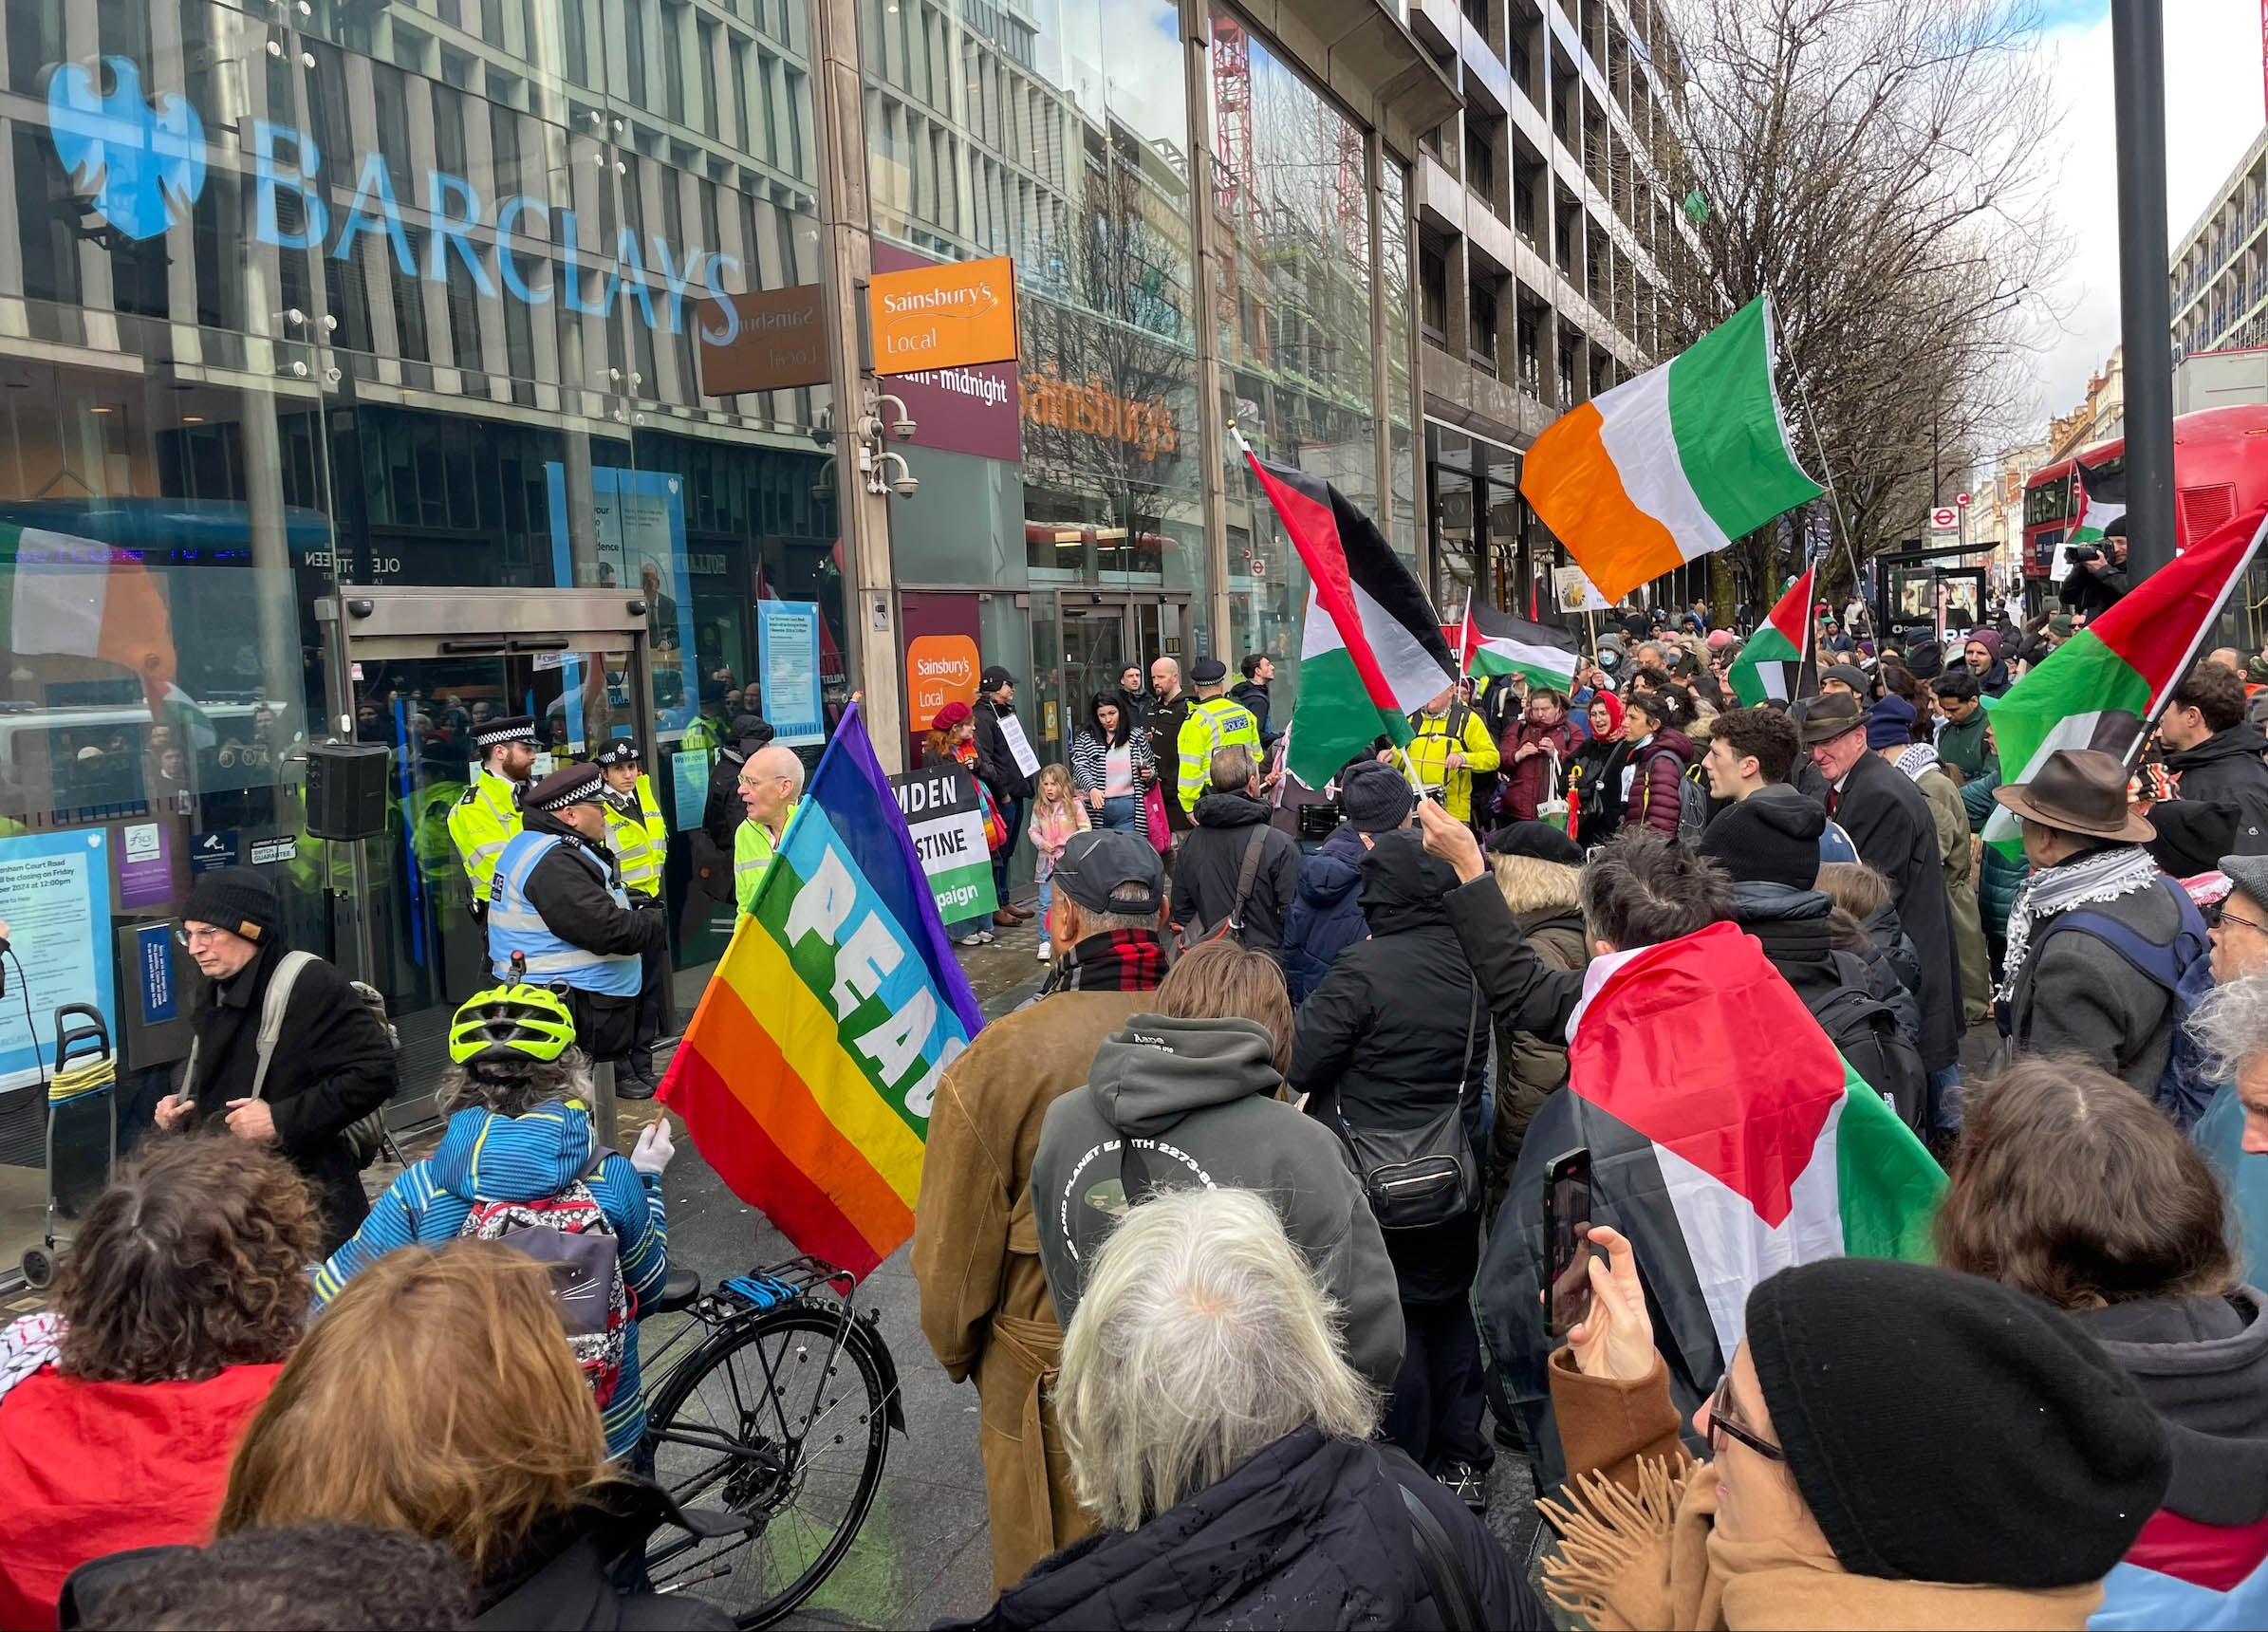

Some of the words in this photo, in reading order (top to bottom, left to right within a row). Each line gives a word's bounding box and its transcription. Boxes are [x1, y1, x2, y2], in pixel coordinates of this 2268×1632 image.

[253, 120, 740, 346] BARCLAYS
[883, 281, 992, 313] Sainsbury's
[887, 327, 937, 354] Local
[939, 368, 1008, 407] midnight
[918, 656, 969, 677] Sainsbury's
[920, 688, 943, 707] Local
[1224, 718, 1249, 732] POLICE
[892, 775, 957, 814] MDEN
[915, 828, 967, 862] STINE
[934, 884, 978, 912] paign
[784, 843, 970, 1118] PEAC
[1061, 1199, 1069, 1237] AND
[1065, 1145, 1100, 1197] PLANET
